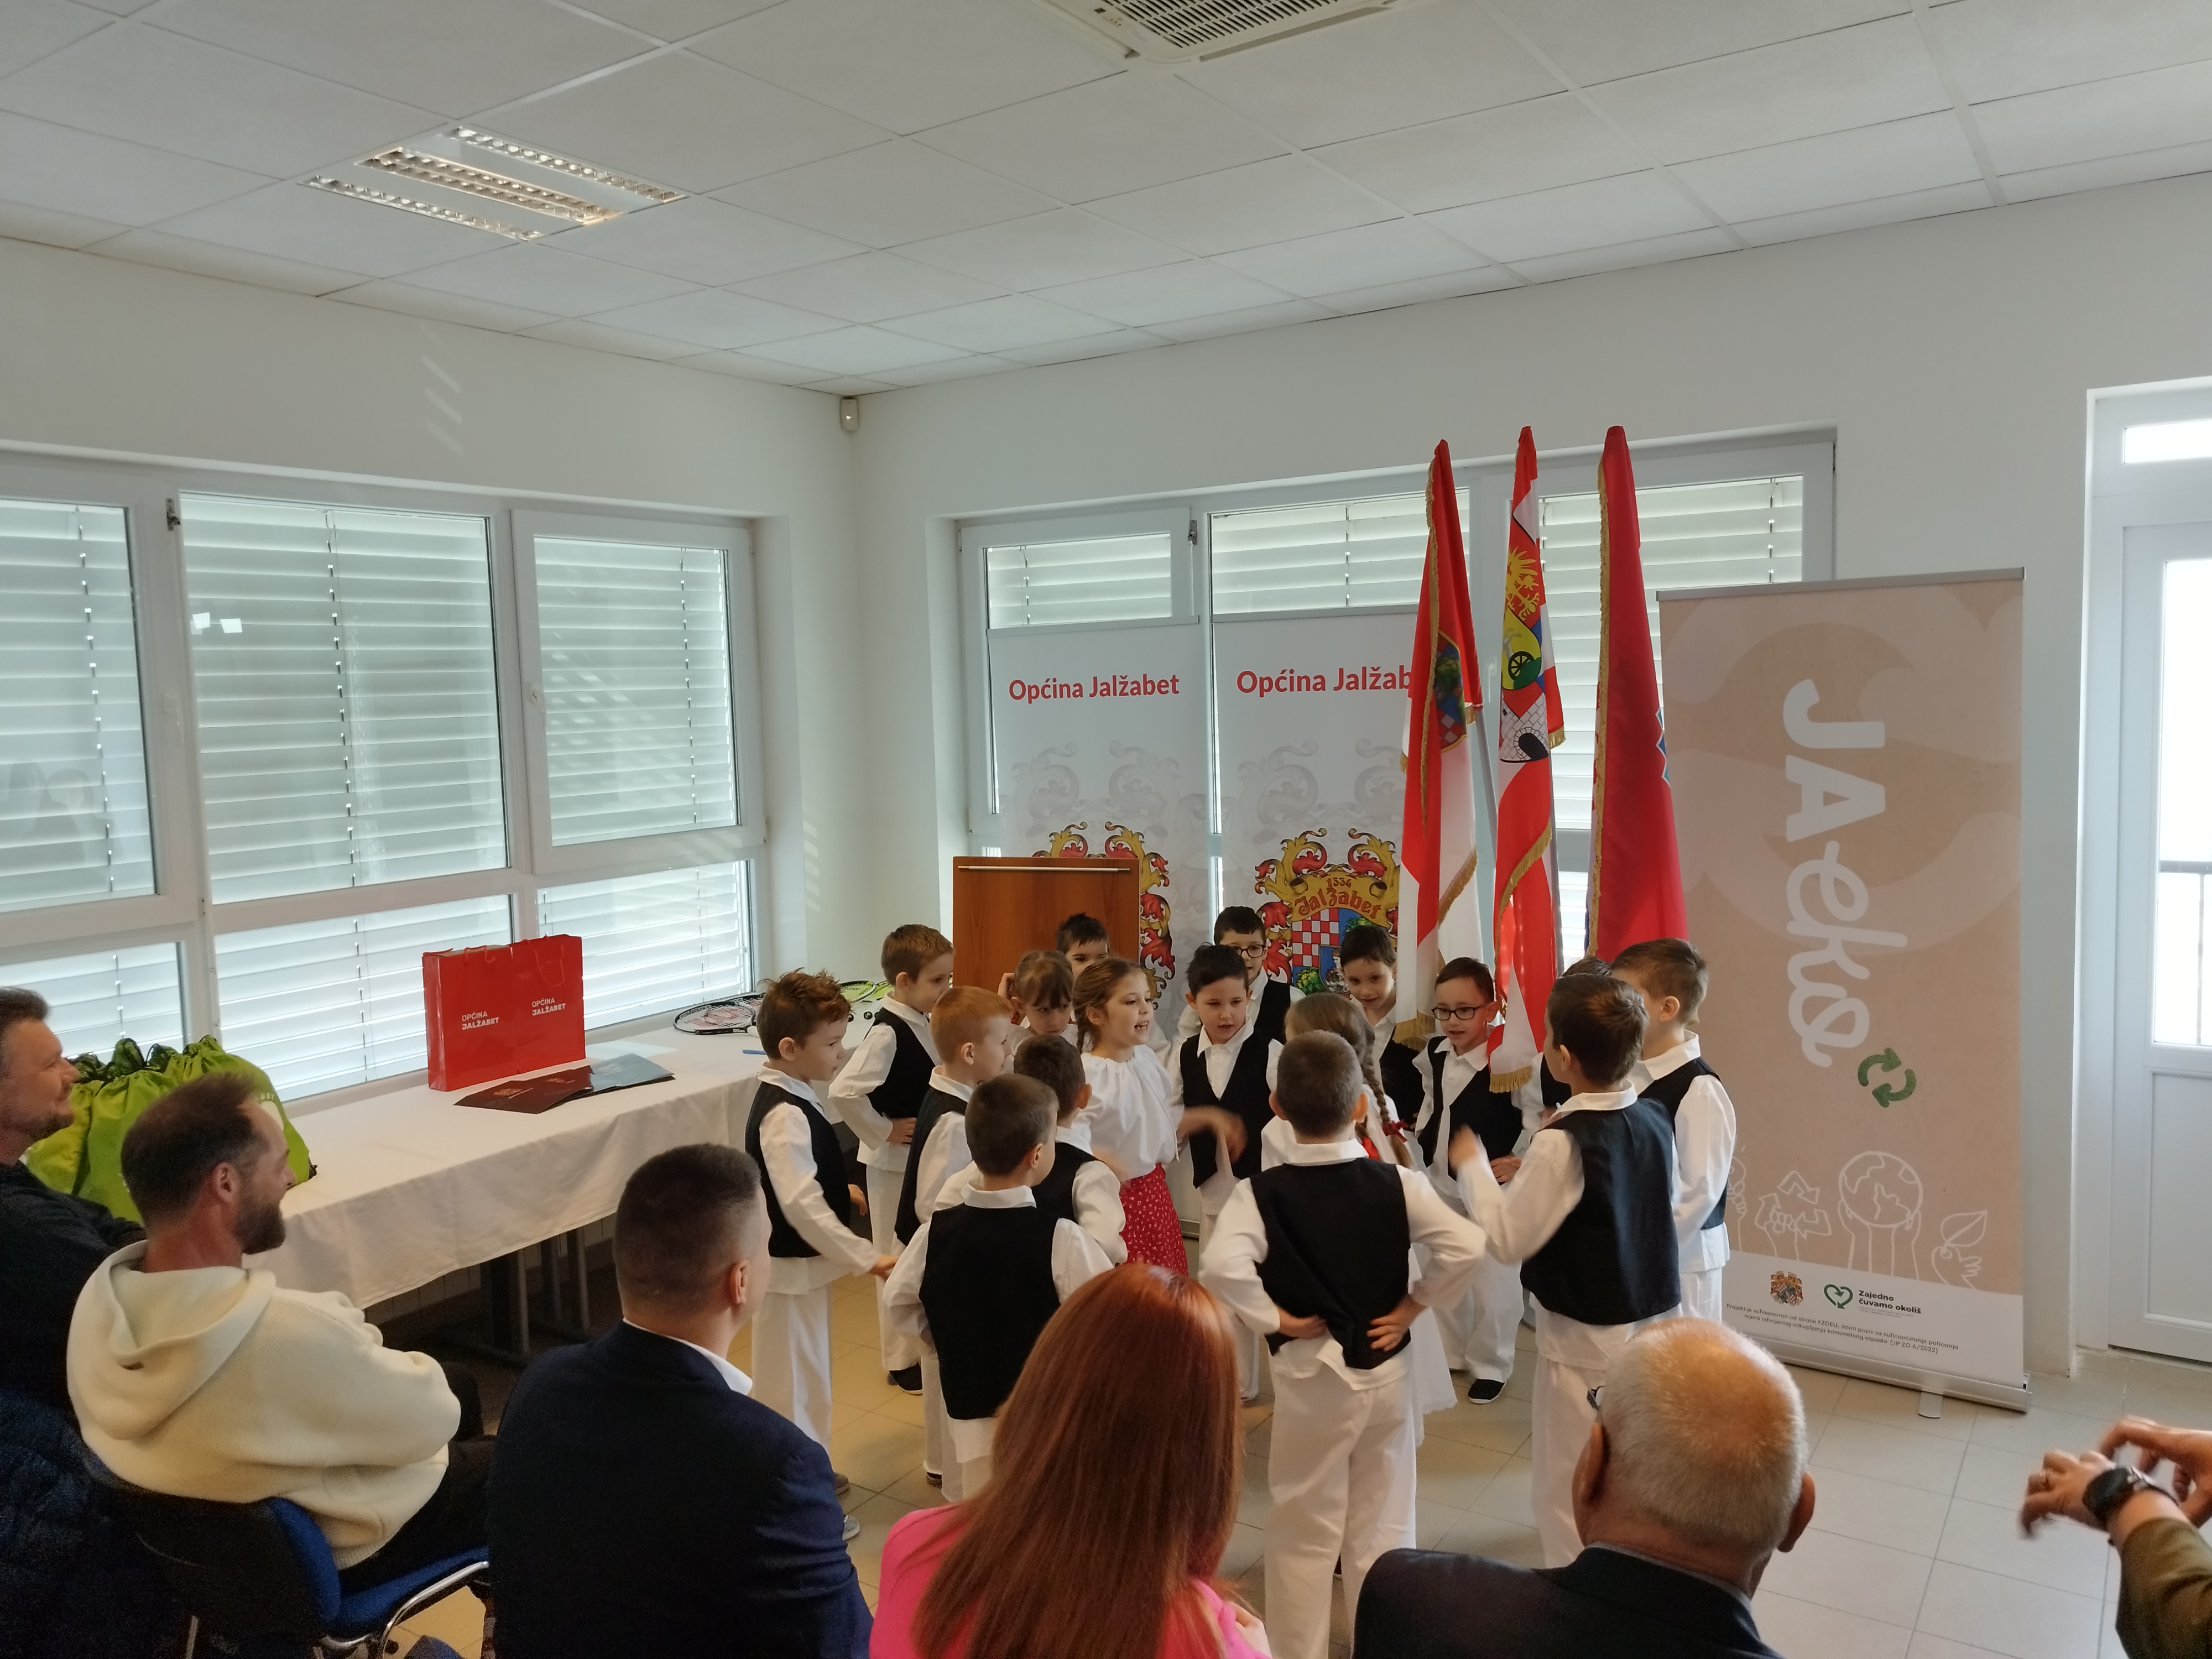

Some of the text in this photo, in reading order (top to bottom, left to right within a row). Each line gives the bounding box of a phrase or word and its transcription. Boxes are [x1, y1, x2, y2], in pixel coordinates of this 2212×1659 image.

[1009, 674, 1180, 704] Općina Jalžabet
[1237, 665, 1412, 698] Općina Jalžab
[1783, 679, 1908, 1067] JAeko
[532, 998, 555, 1008] OPĆINA
[532, 1003, 566, 1016] JALŽABET
[462, 1011, 488, 1021] OPĆINA
[462, 1017, 499, 1030] JALŽABET
[1859, 1290, 1894, 1301] Zajedno
[1859, 1298, 1893, 1310] čuvamo
[1896, 1305, 1922, 1314] okoliš
[1754, 1308, 1788, 1319] sufinanciran
[1818, 1320, 1839, 1328] FZOEU,
[1884, 1332, 1927, 1344] sufinanciranje
[1928, 1340, 1959, 1350] poticanja
[1761, 1317, 1791, 1327] odvojenog
[1793, 1323, 1826, 1333] sakupljanja
[1827, 1328, 1864, 1340] komunalnog
[1865, 1335, 1887, 1344] otpada
[1912, 1344, 1938, 1354] 6/2022)
